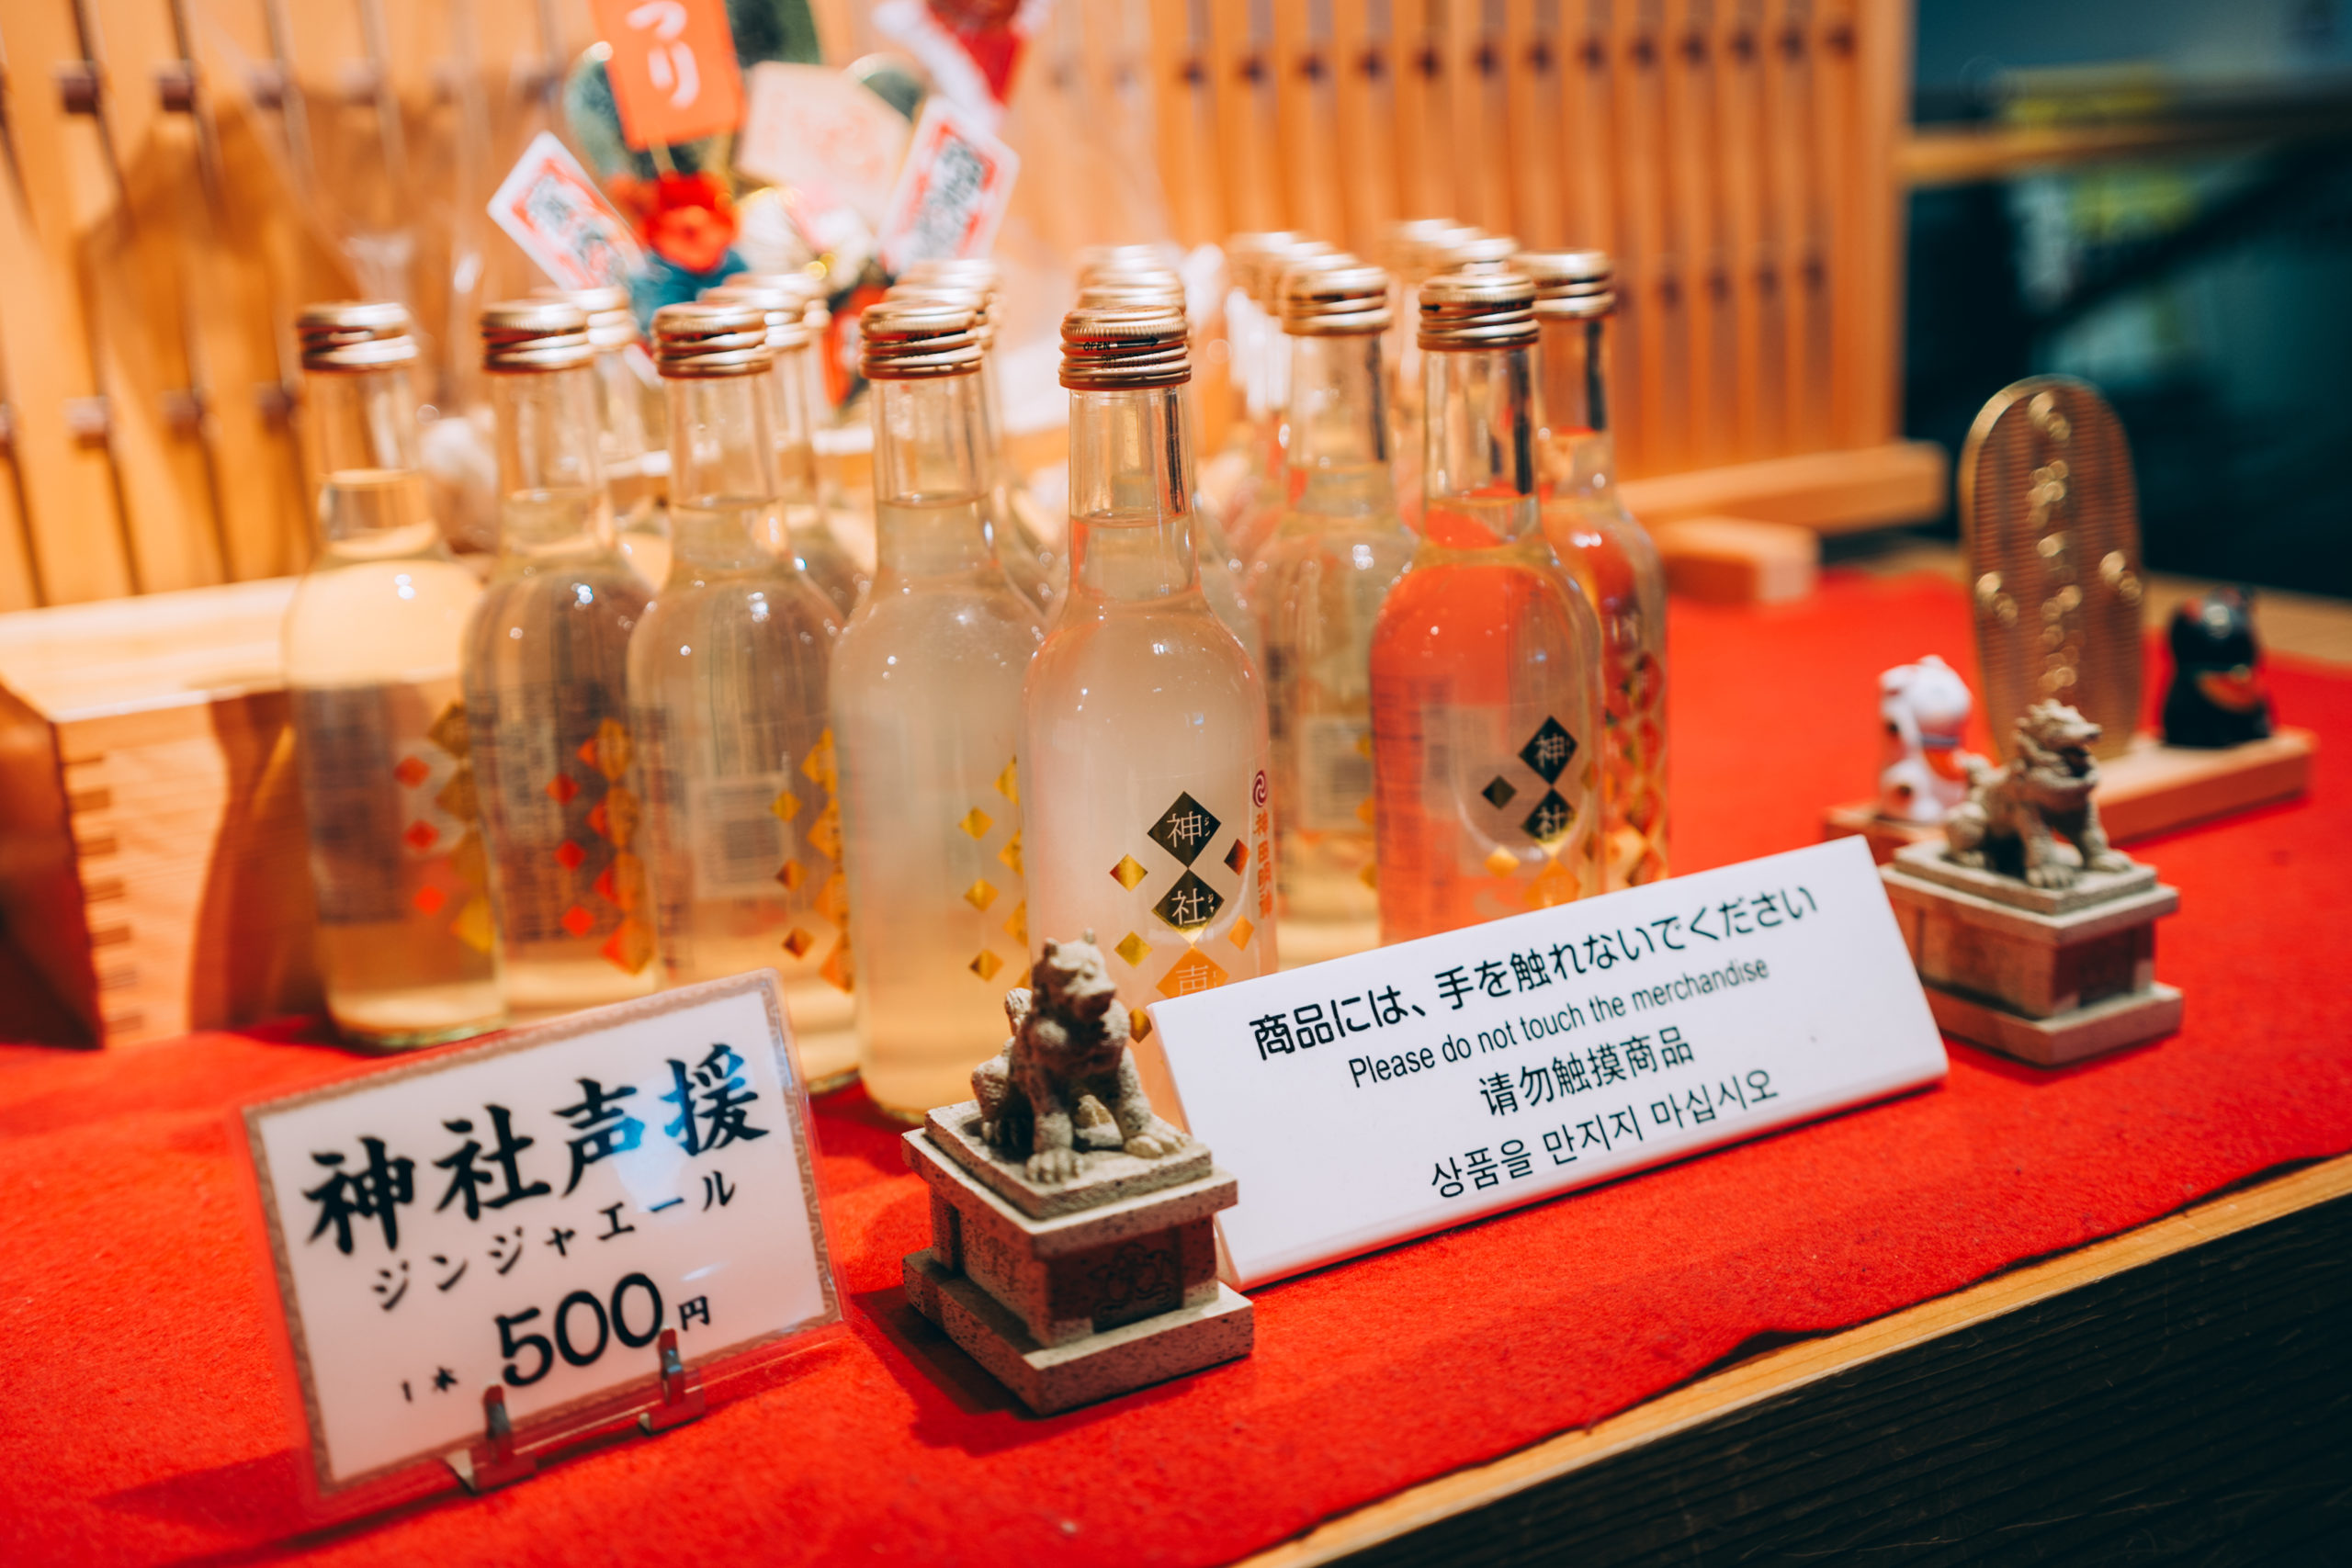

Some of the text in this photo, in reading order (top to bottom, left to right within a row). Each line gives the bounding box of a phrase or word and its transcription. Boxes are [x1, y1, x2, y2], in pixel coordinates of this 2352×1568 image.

[1083, 341, 1111, 352] OPEN
[1349, 958, 1770, 1088] Please do not touch the merchandise
[1479, 1026, 1694, 1116] 请勿触摸商品
[302, 1043, 770, 1256] 神社声援
[1431, 1070, 1779, 1198] 상품을 만지지 마십시오
[373, 1170, 736, 1311] ジンジャエール
